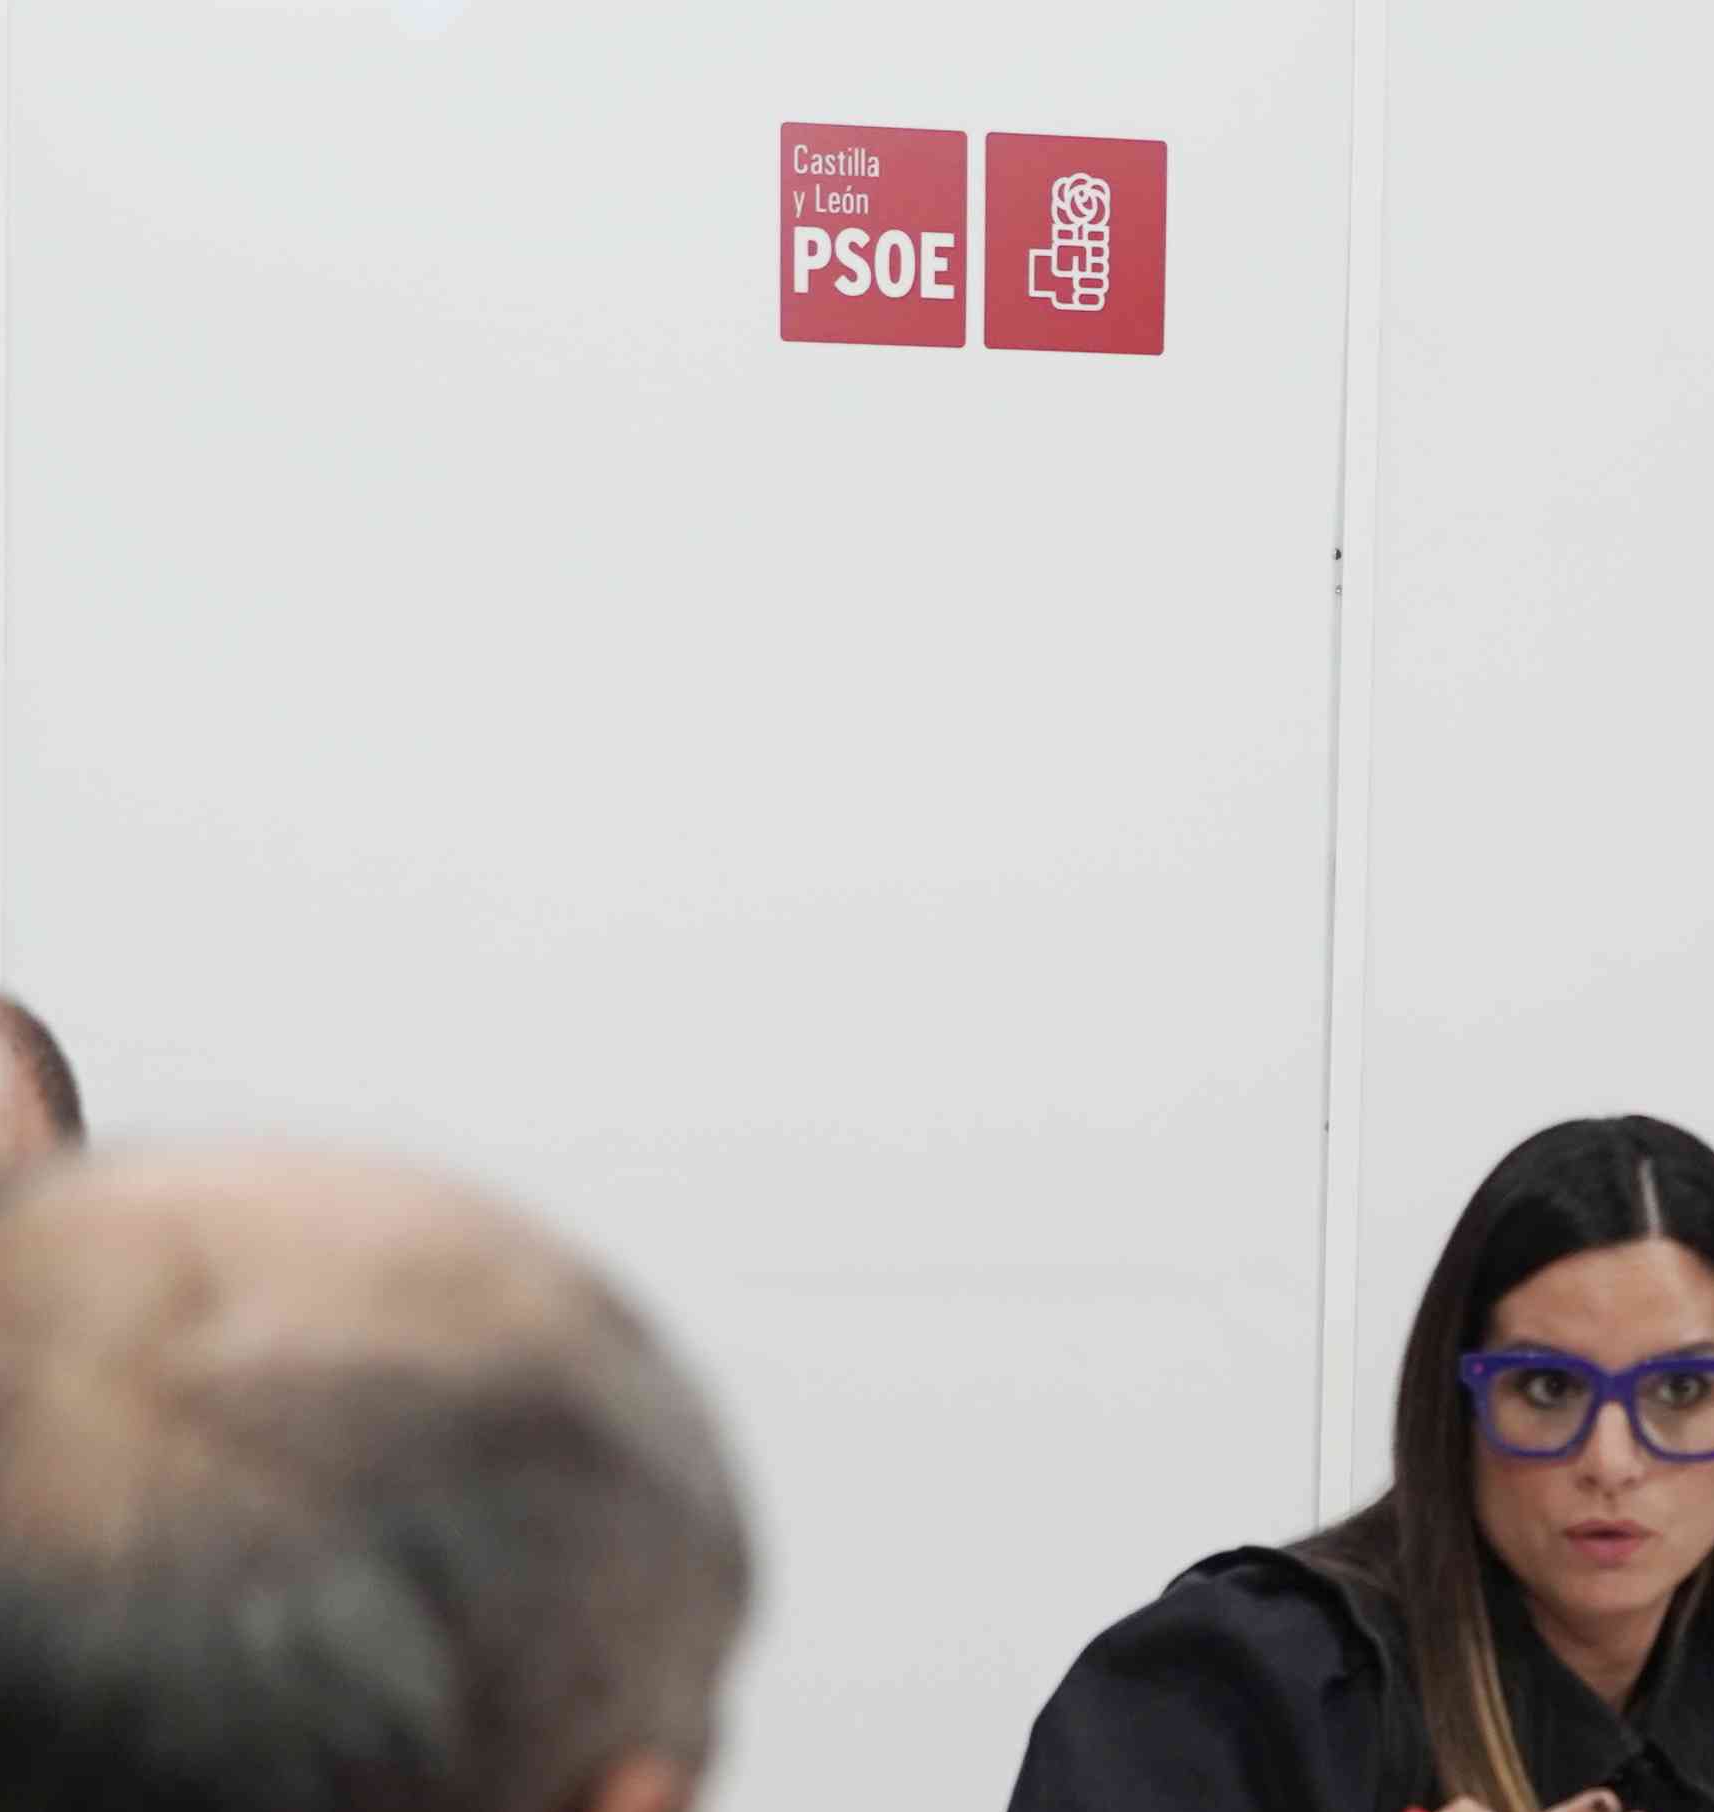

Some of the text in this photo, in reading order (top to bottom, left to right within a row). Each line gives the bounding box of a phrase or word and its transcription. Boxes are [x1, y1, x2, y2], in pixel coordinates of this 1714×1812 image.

[792, 143, 880, 178] Castilla
[793, 185, 869, 218] y León
[791, 225, 956, 300] PSOE
